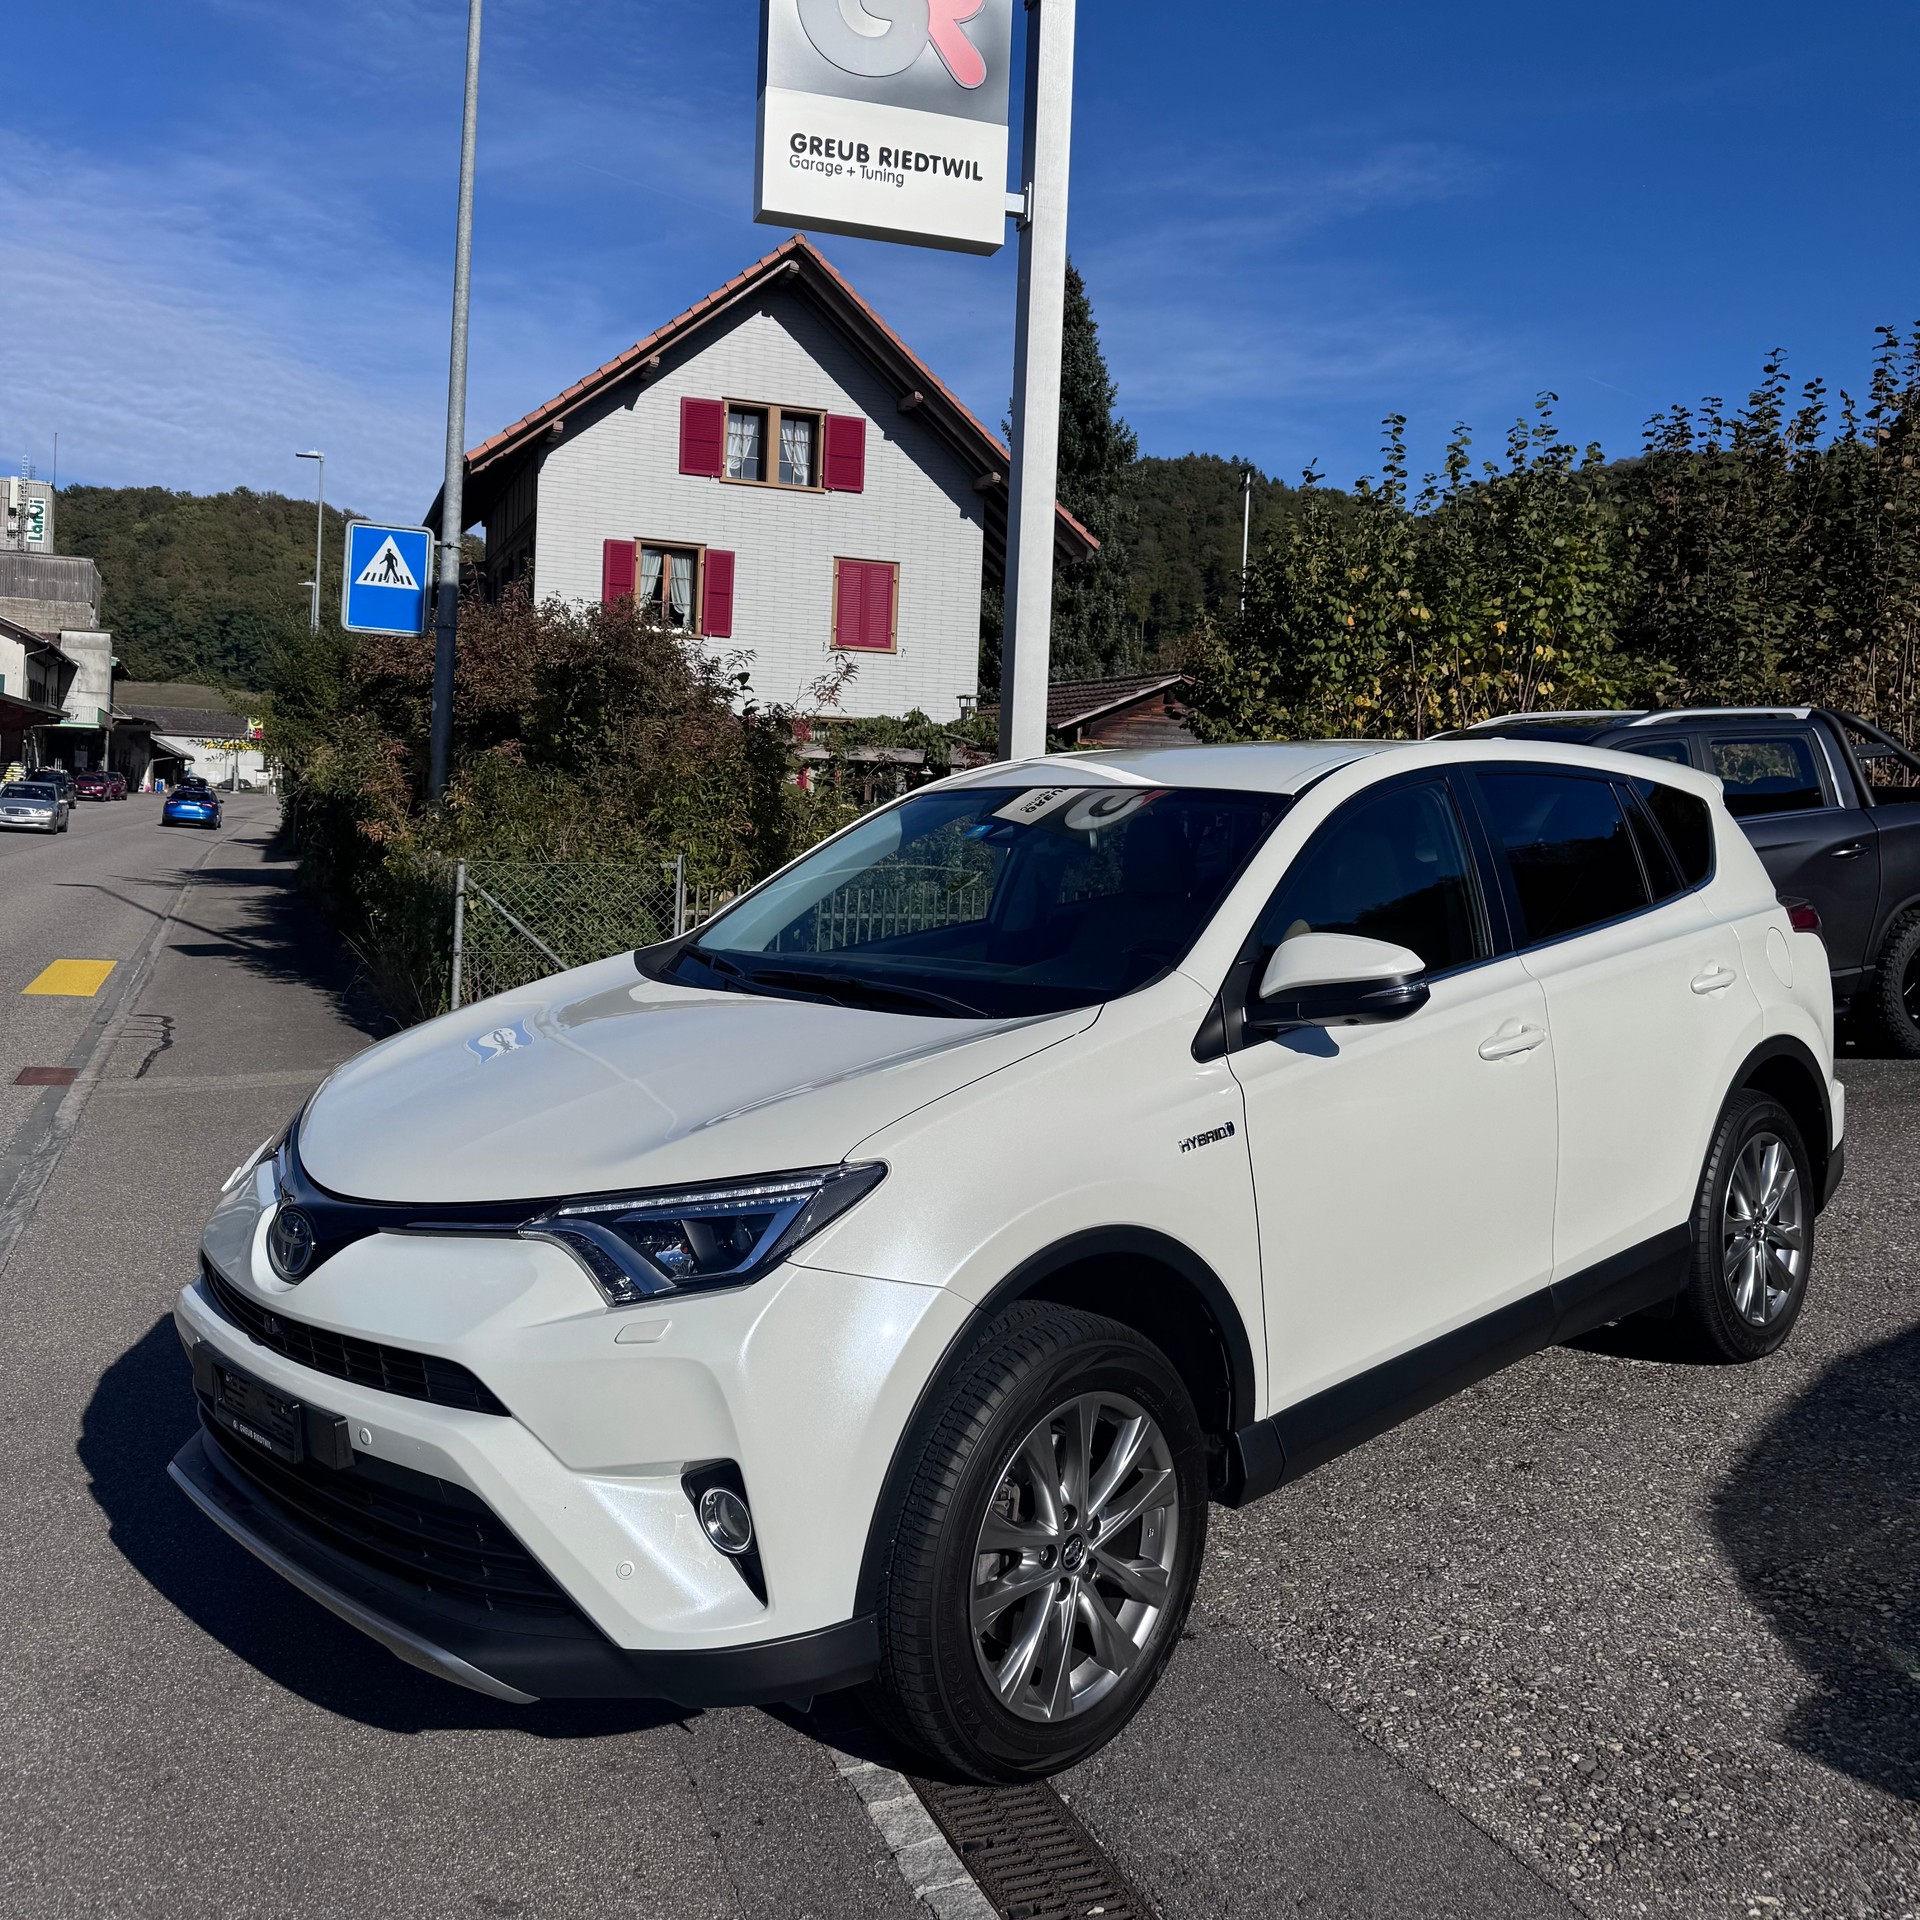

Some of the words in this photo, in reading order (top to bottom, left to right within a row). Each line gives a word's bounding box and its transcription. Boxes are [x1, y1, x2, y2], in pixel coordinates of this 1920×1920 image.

[789, 132, 870, 164] GREUB
[878, 146, 984, 182] RIEDTWIL
[789, 154, 843, 177] Garage
[846, 166, 856, 176] +
[859, 164, 904, 188] Tuning
[1178, 1126, 1228, 1153] HYBRID
